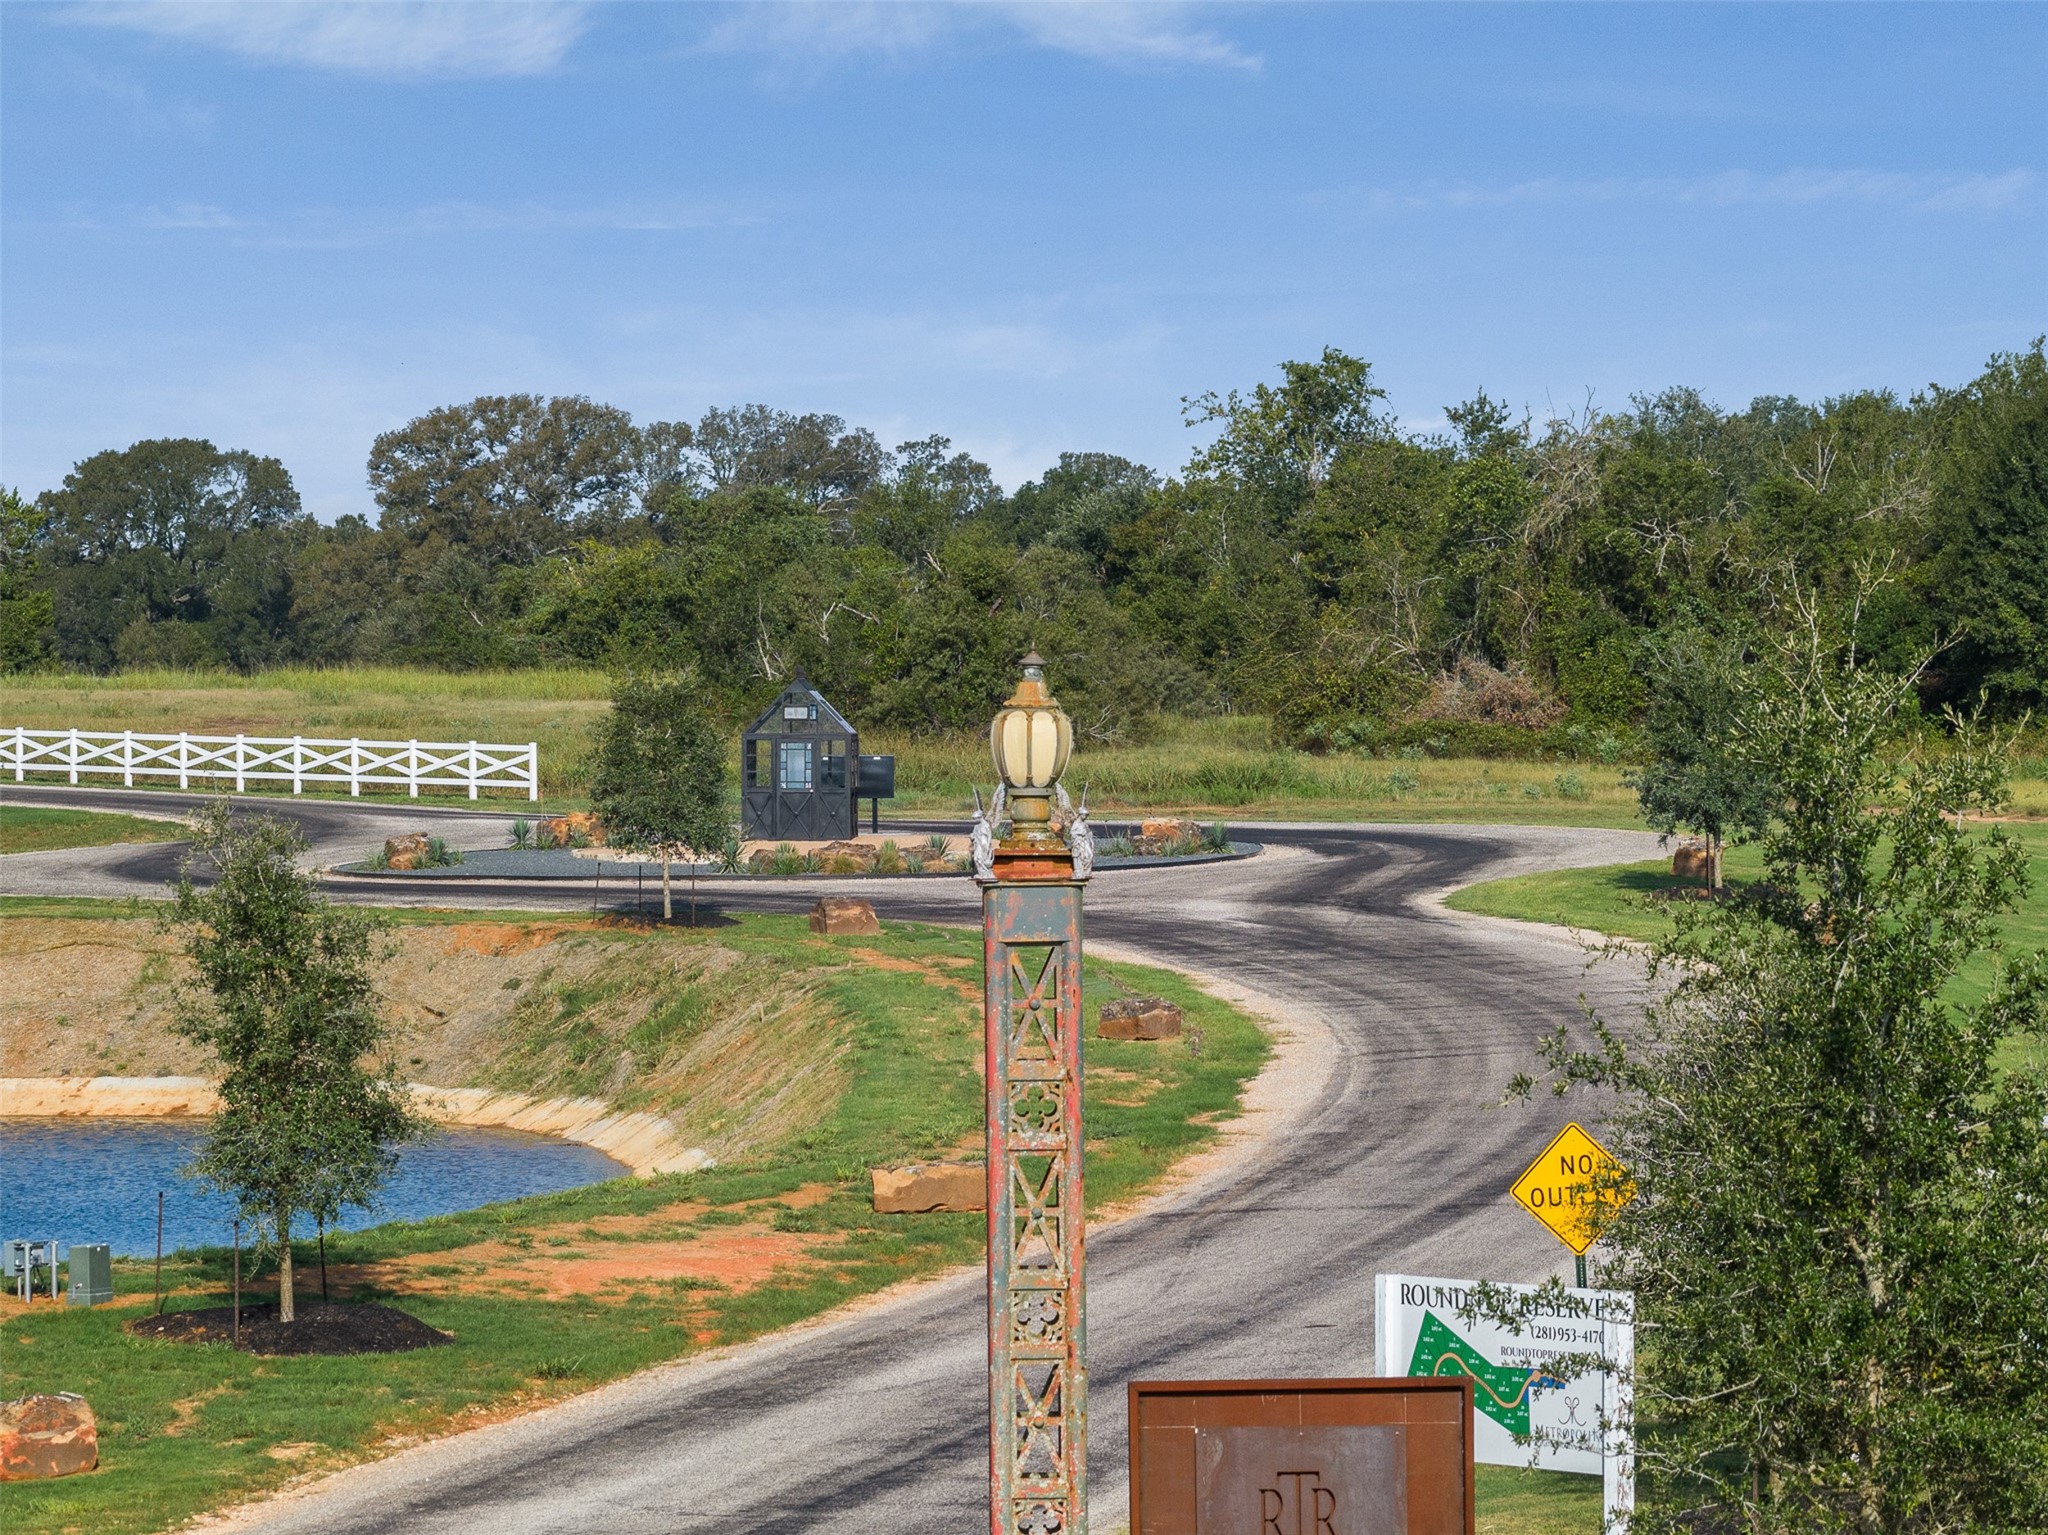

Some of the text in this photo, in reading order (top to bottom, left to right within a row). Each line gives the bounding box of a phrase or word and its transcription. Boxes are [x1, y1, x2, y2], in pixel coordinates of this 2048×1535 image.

[1560, 1155, 1593, 1175] NO
[1530, 1187, 1623, 1208] OUTL
[1400, 1283, 1469, 1310] ROUND
